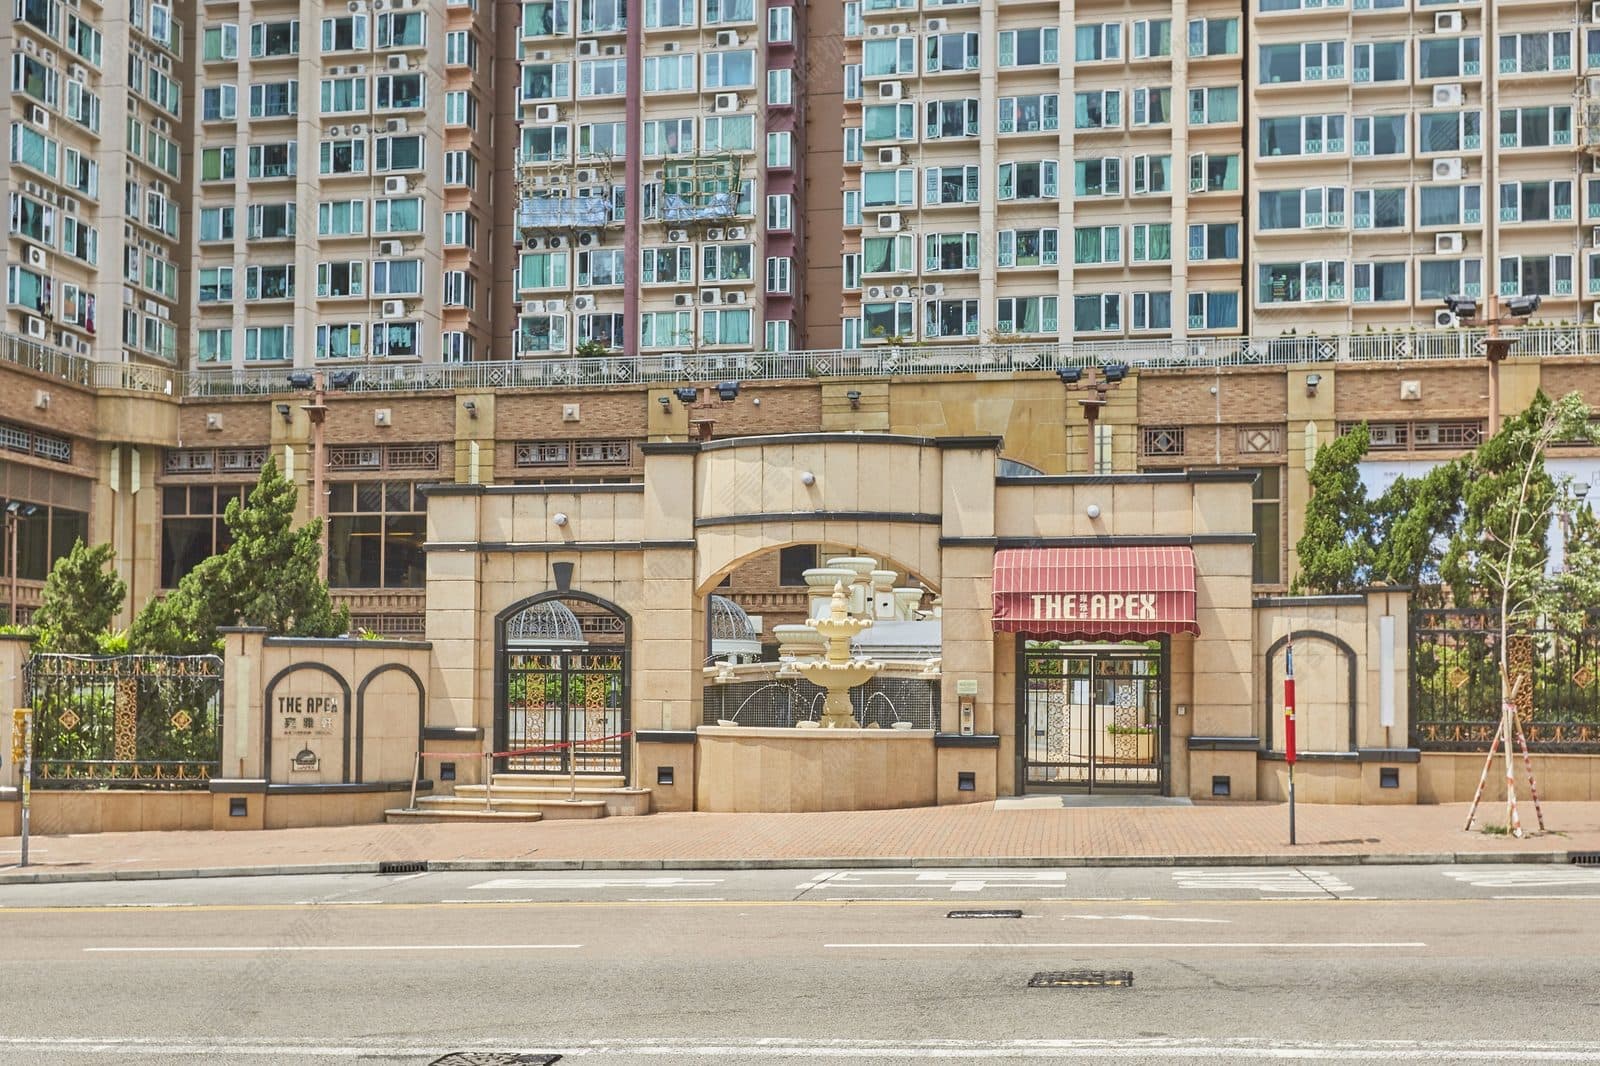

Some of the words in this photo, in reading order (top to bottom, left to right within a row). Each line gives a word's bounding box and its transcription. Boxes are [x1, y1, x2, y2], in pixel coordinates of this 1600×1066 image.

[1032, 594, 1076, 619] THE
[1091, 594, 1156, 619] APEX
[278, 697, 302, 713] THE
[307, 697, 338, 713] APEX
